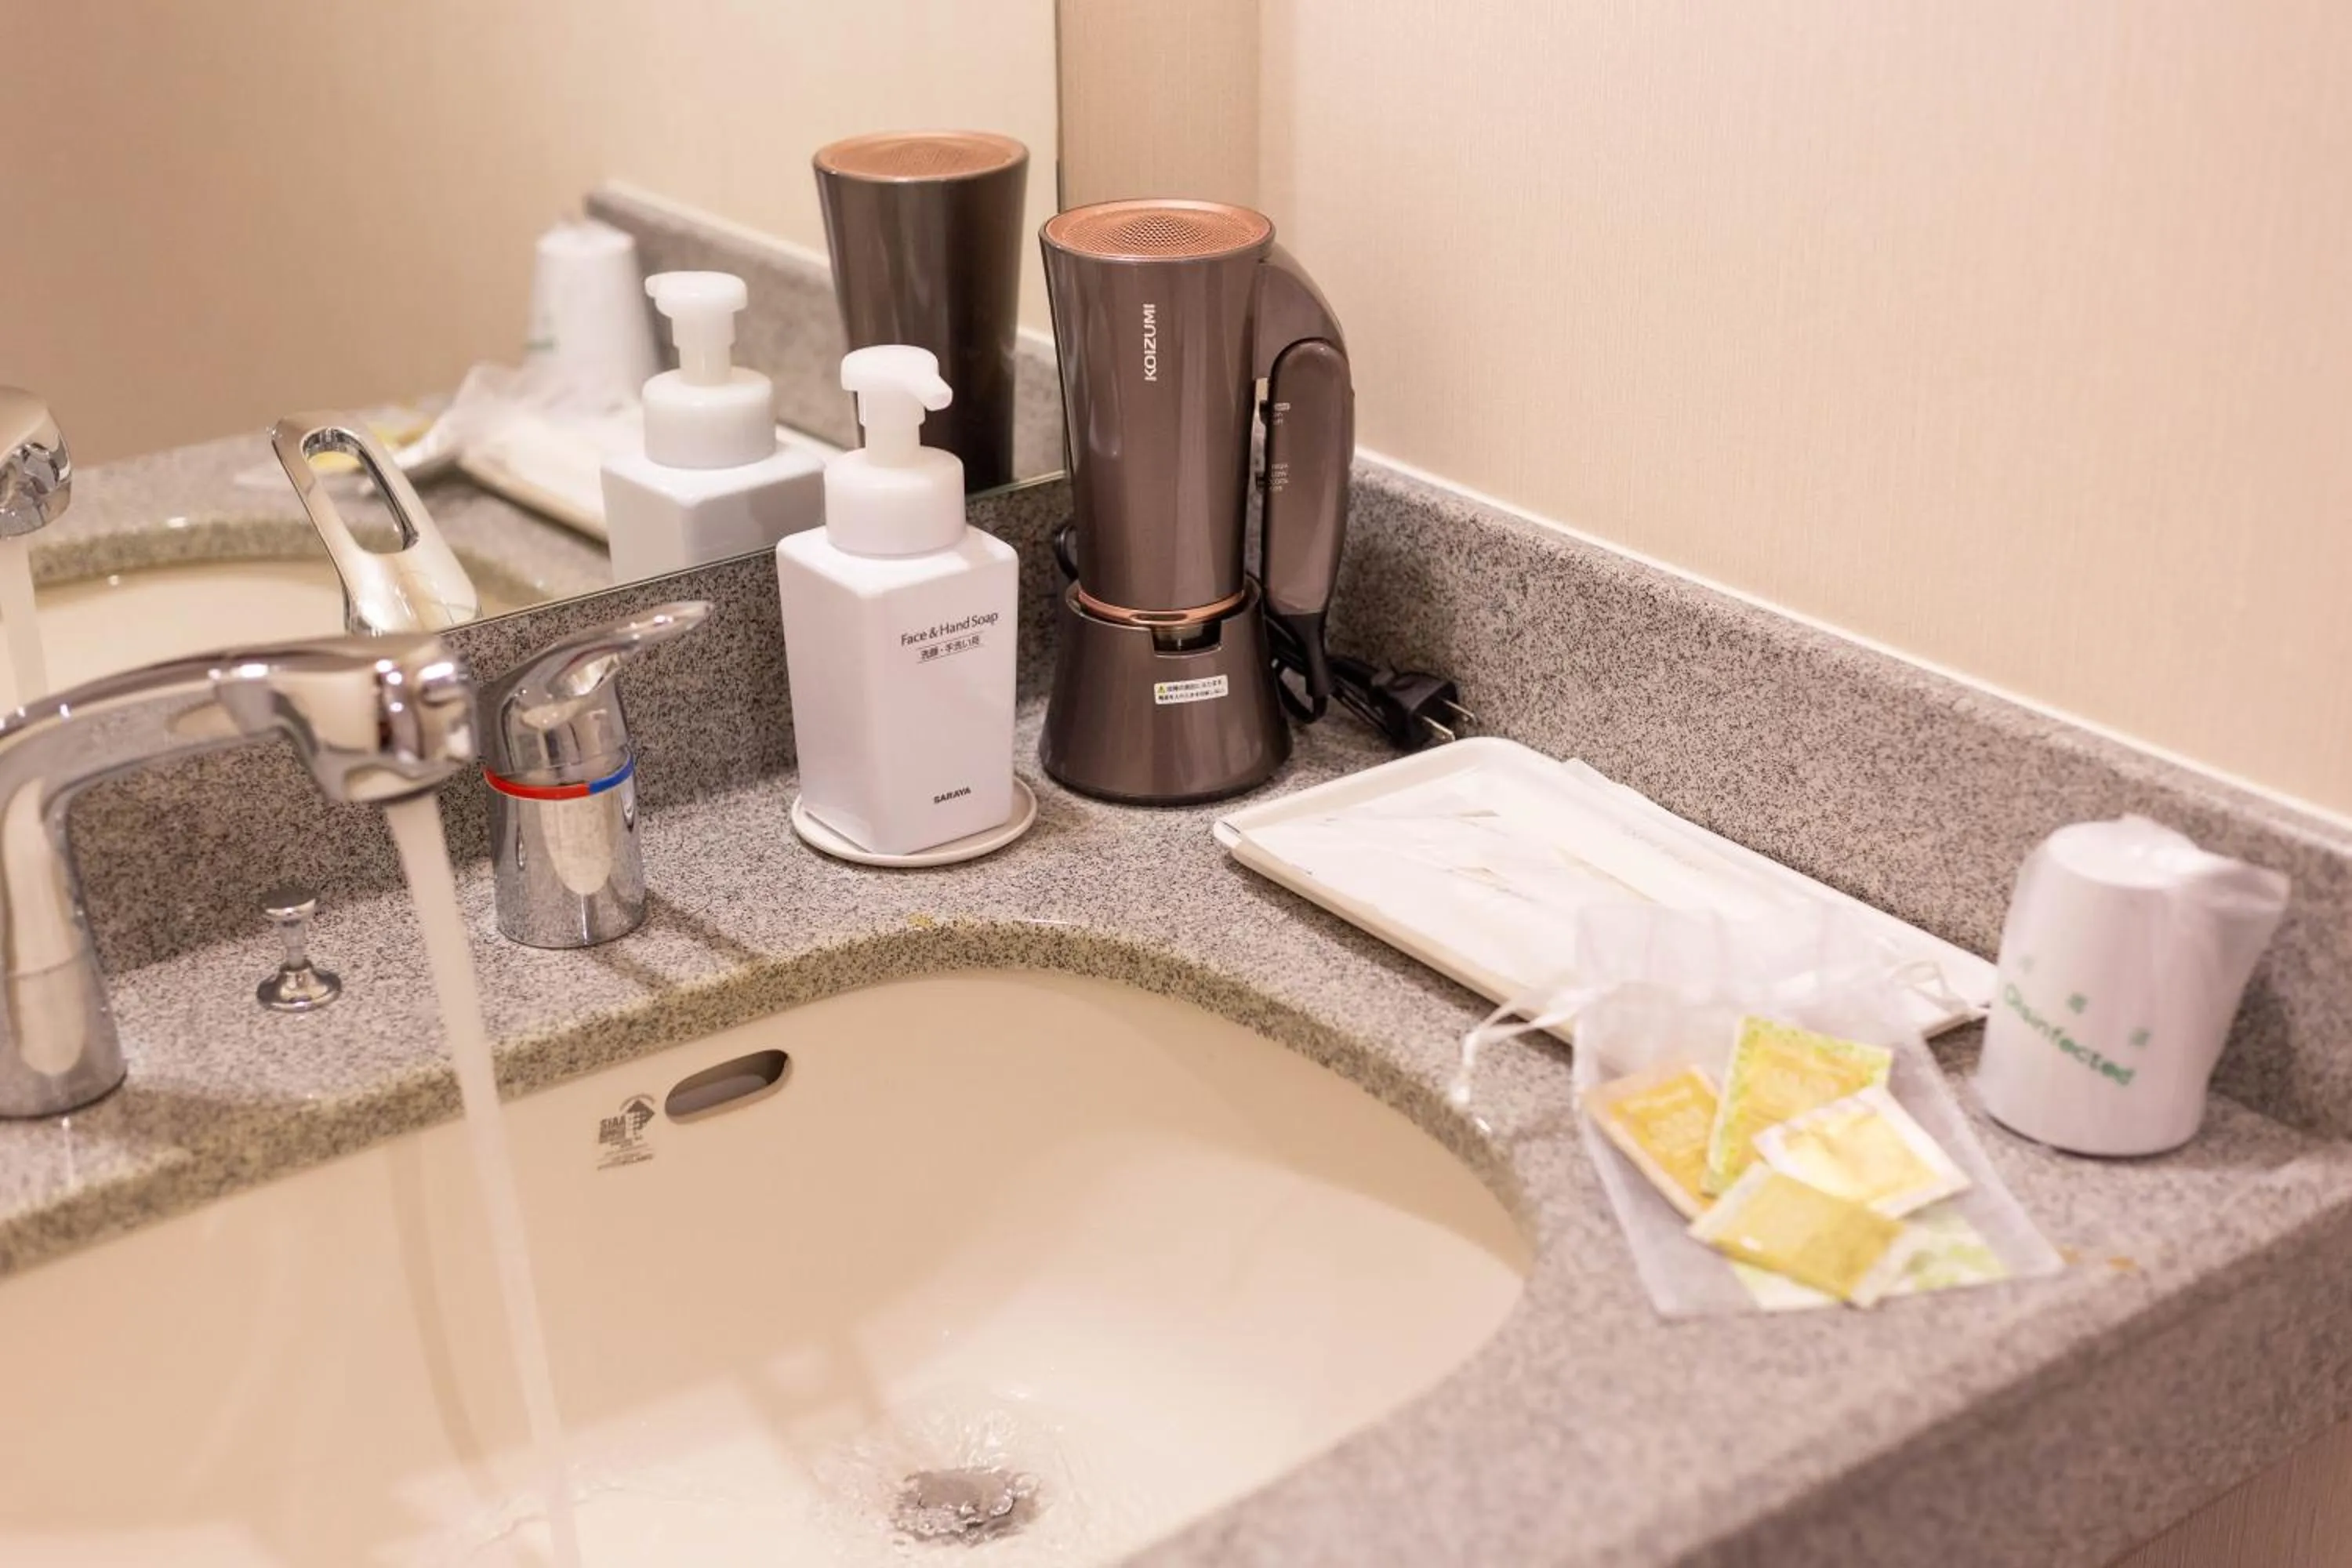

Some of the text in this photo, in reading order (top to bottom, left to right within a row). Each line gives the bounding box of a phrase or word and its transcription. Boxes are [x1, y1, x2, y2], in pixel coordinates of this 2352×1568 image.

[1143, 303, 1157, 382] KOIZUMI
[901, 612, 999, 647] Face & Hand Soap
[934, 786, 971, 804] SARAYA
